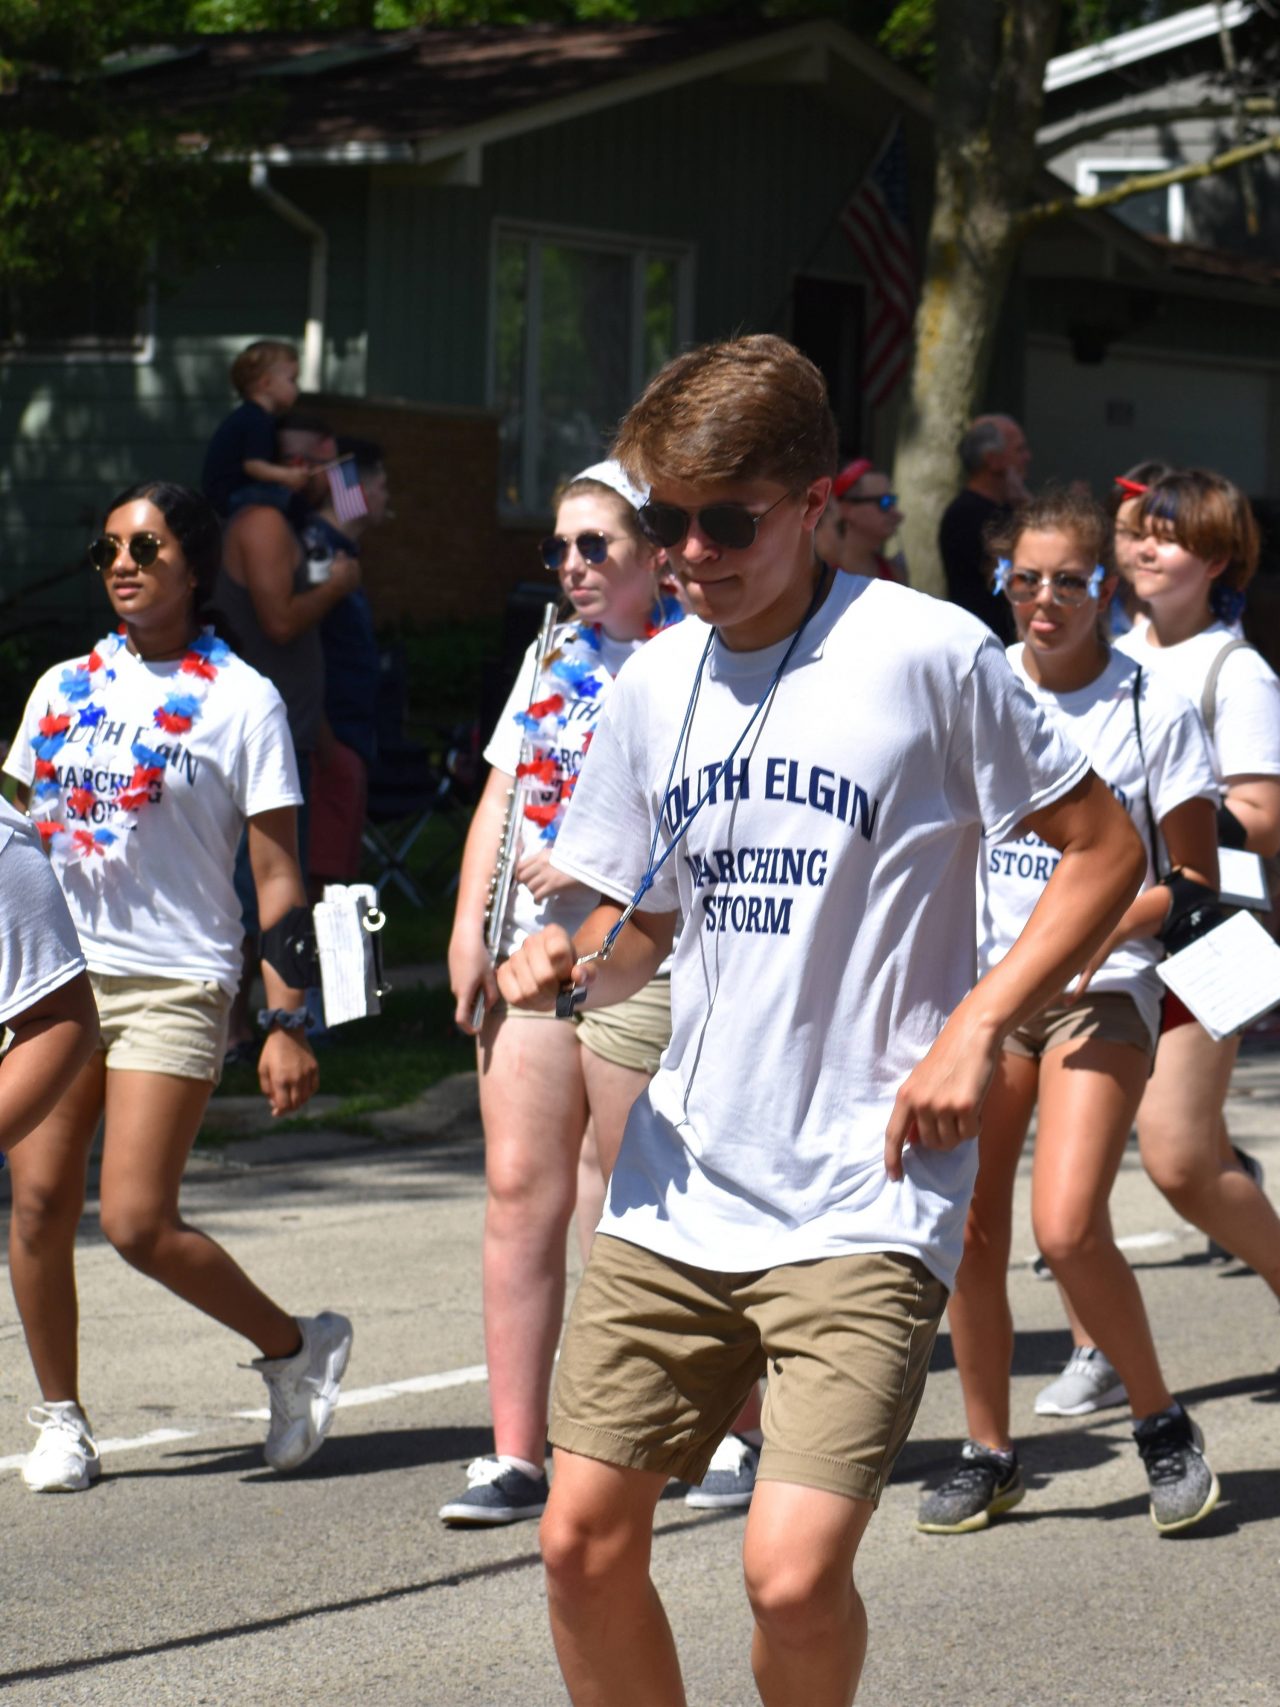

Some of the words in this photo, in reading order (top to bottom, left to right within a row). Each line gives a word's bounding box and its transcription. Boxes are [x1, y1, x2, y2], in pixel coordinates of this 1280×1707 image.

[664, 757, 750, 835] OUTH
[765, 757, 879, 842] ELGIN
[989, 848, 1060, 882] STOR
[703, 895, 793, 935] STORM
